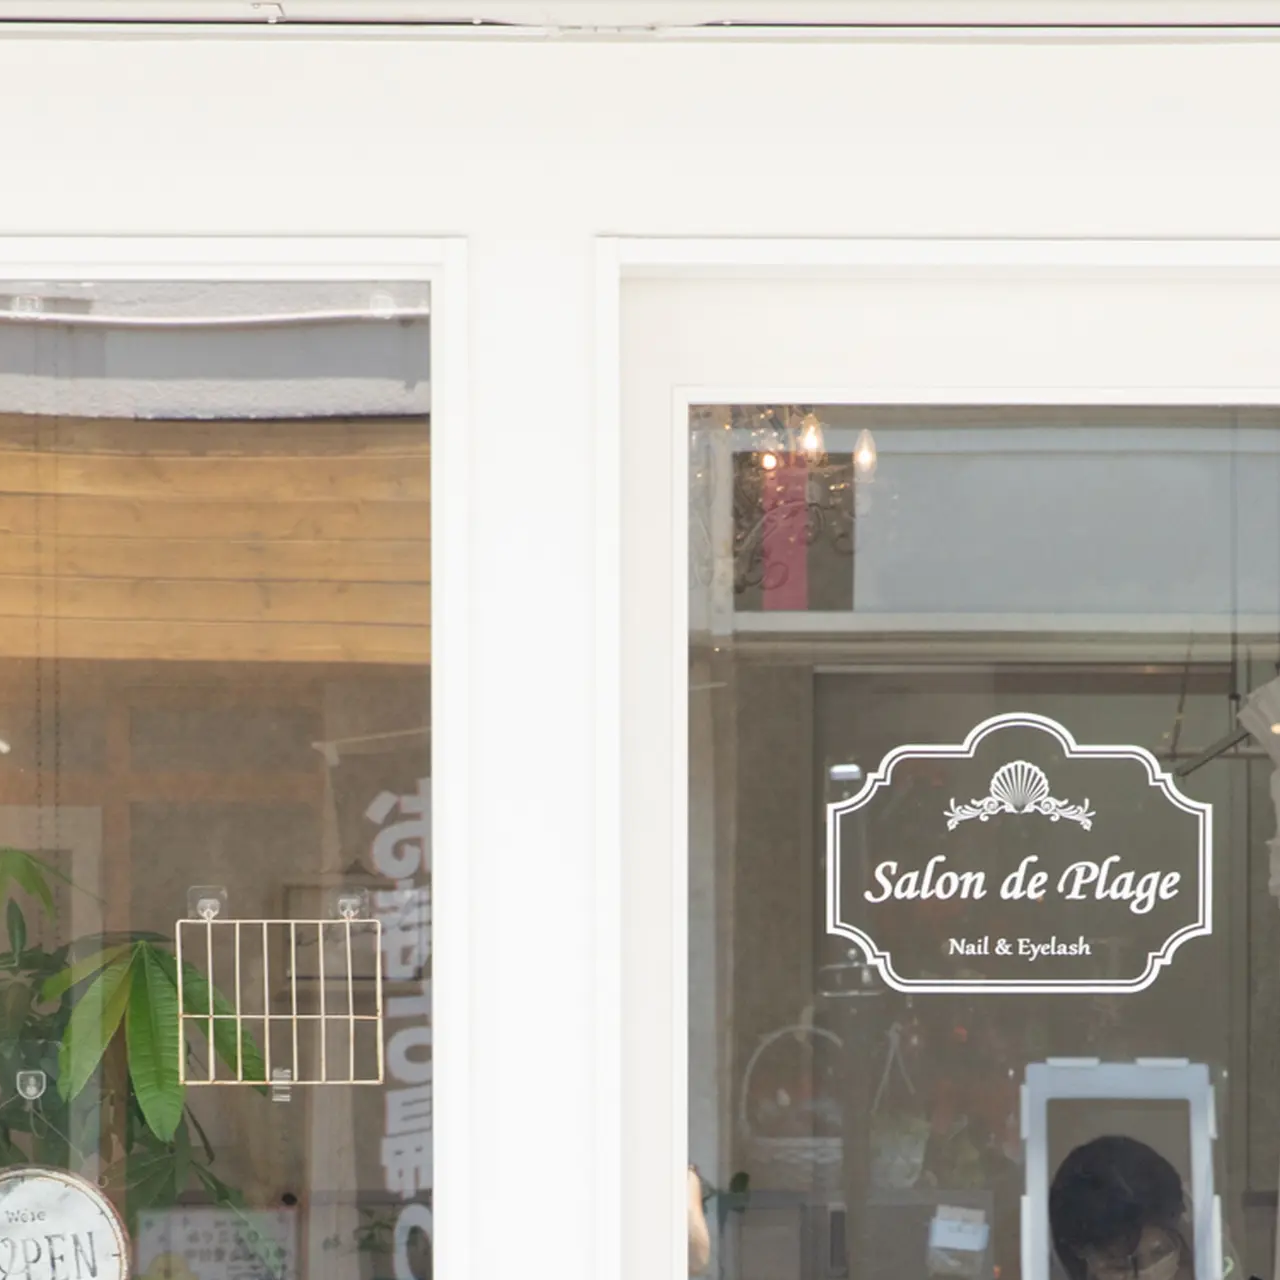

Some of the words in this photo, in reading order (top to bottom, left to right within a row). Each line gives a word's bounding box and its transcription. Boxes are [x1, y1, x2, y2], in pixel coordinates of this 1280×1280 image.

[863, 855, 987, 903] Salon
[999, 855, 1049, 901] de
[1057, 854, 1181, 914] Plage
[949, 936, 989, 955] Nail
[995, 938, 1013, 955] &
[1017, 935, 1092, 962] Eyelash
